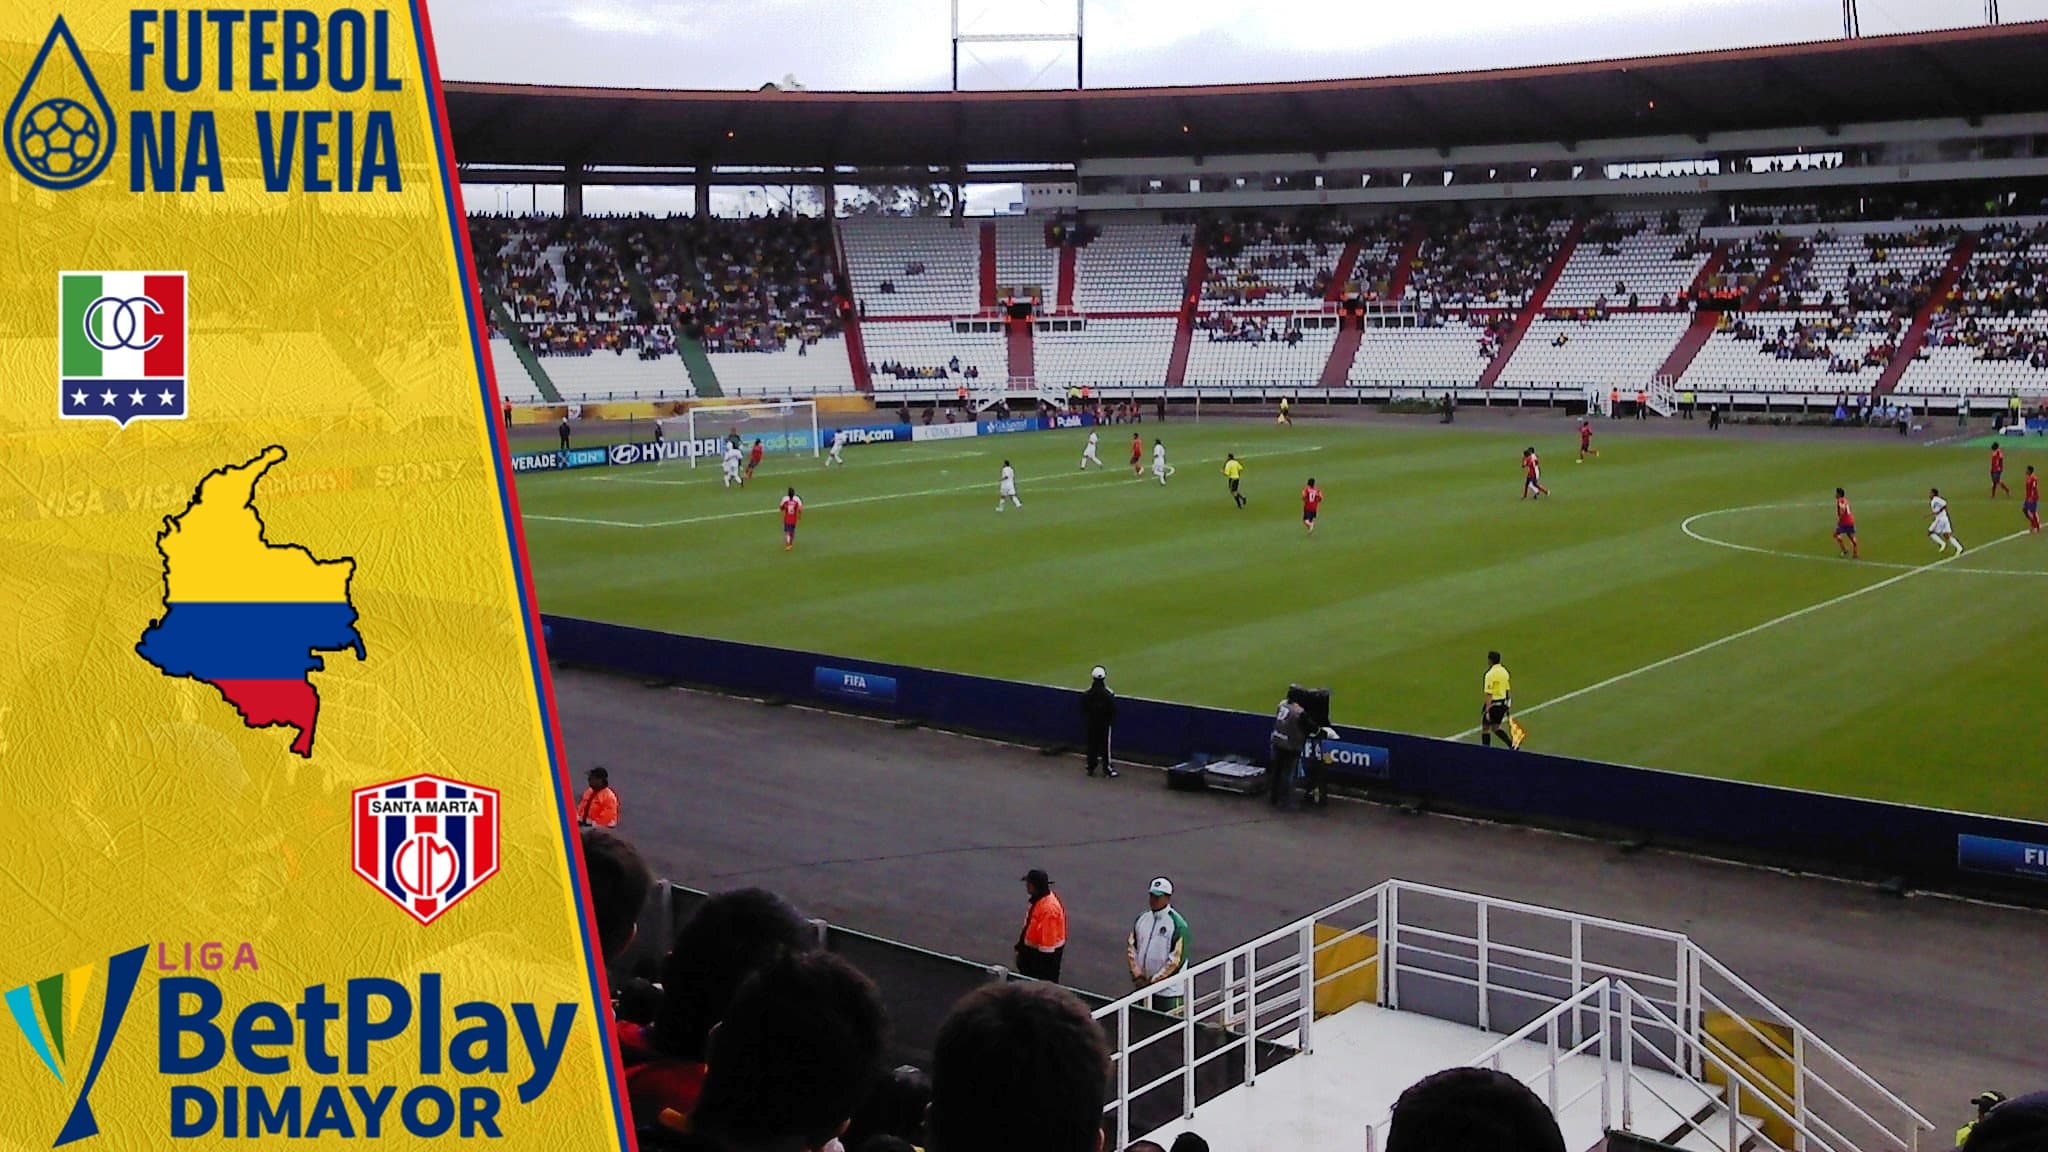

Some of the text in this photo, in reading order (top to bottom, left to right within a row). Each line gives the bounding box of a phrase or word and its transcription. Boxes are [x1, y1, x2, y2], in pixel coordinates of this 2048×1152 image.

[642, 438, 720, 462] HYUNDAI
[374, 460, 465, 488] SONY
[843, 674, 867, 689] FIFA
[2024, 847, 2048, 867] FI
